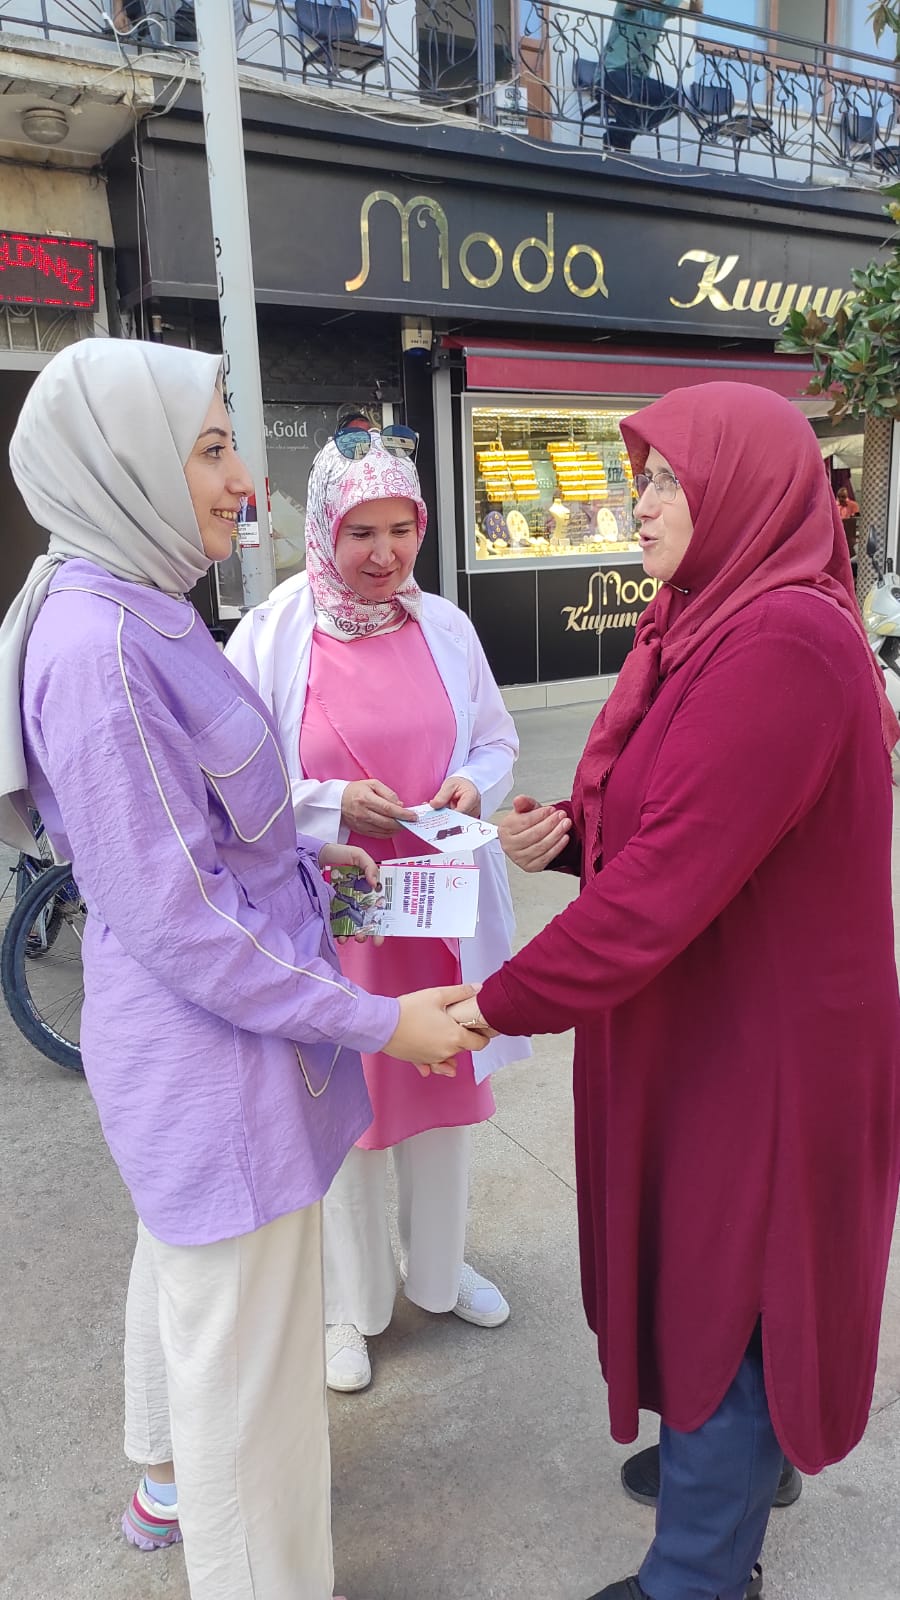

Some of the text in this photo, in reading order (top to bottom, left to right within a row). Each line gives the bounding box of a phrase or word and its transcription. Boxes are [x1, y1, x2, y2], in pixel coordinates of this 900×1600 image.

[345, 190, 865, 326] Moda Kuyum
[583, 570, 664, 613] Mod
[560, 606, 641, 635] Kuyum
